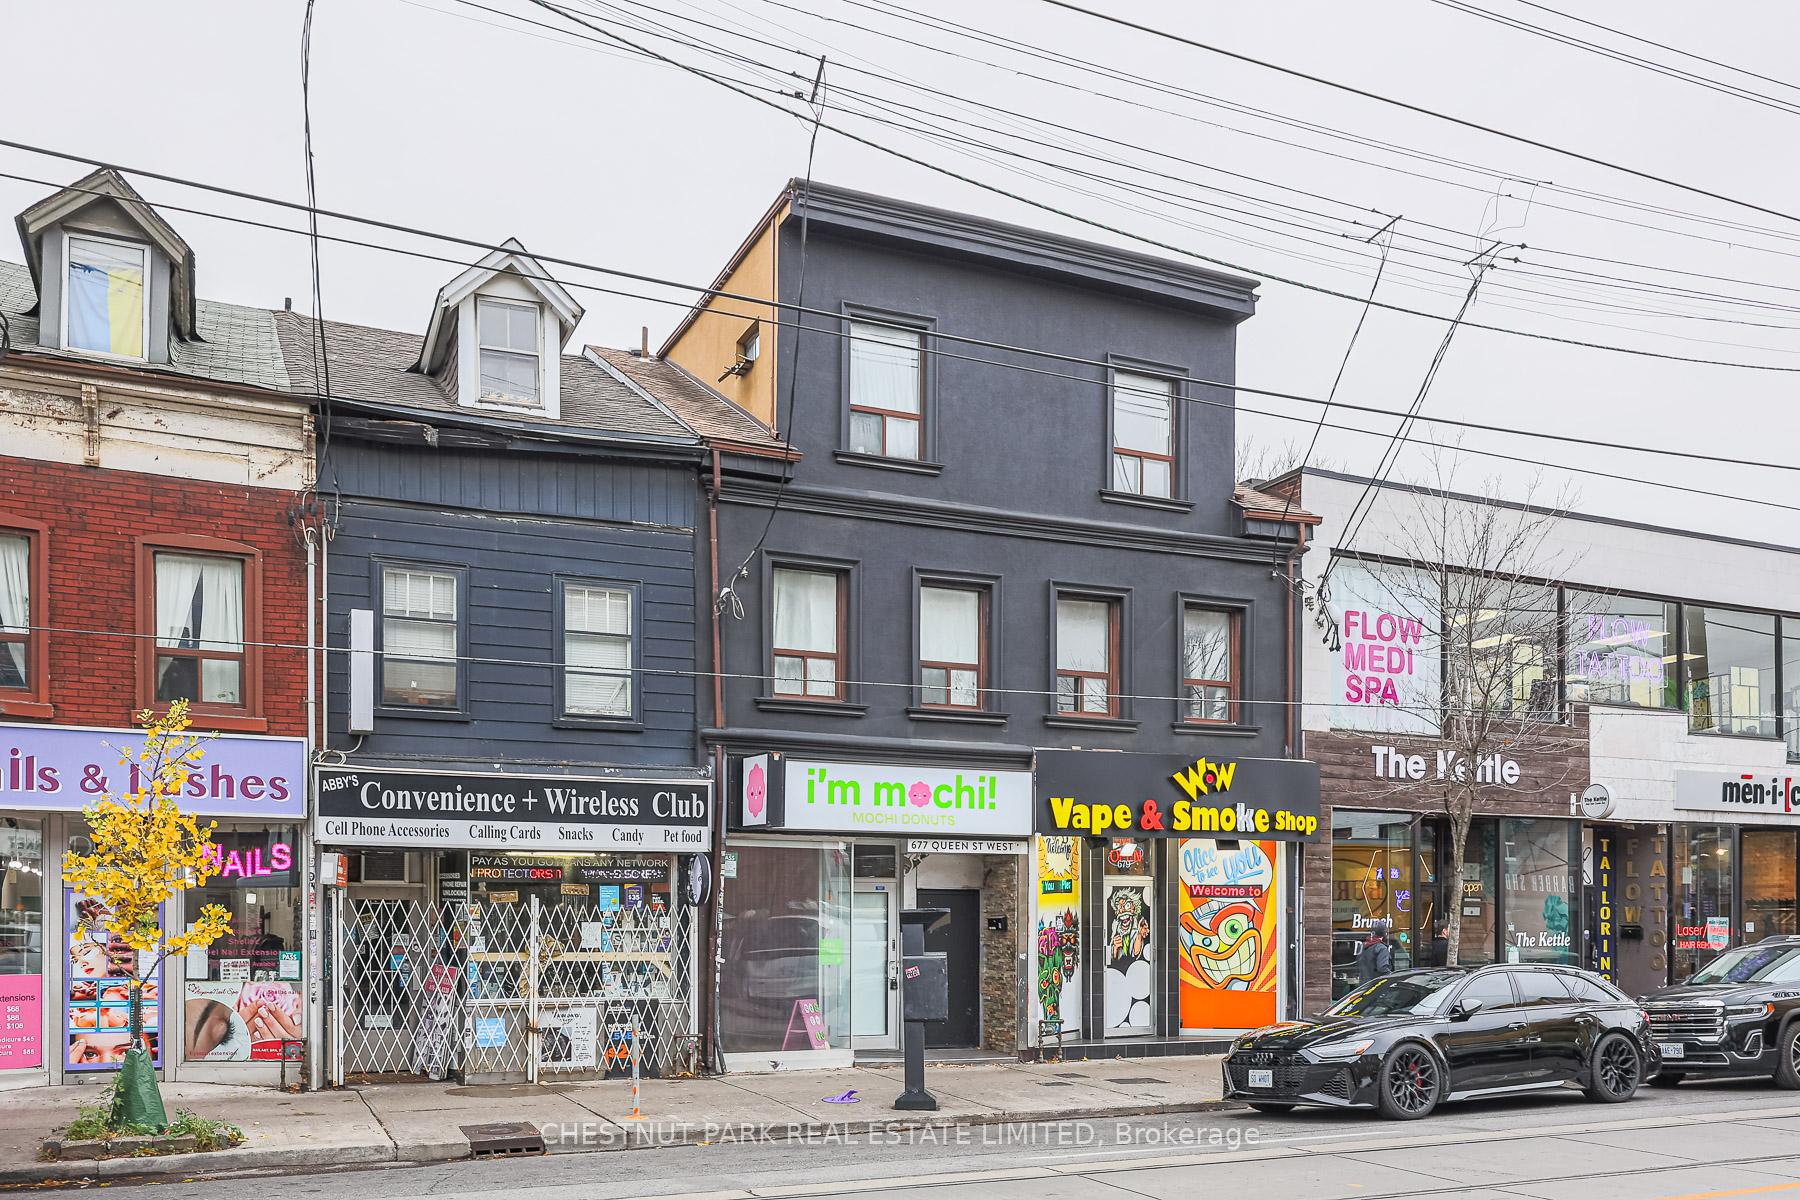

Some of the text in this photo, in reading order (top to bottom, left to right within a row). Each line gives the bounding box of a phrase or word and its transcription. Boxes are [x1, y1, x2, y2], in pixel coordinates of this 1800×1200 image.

[1345, 610, 1422, 644] FLOW
[1588, 615, 1650, 646] FLOW
[1345, 643, 1413, 675] MEDI
[1576, 650, 1664, 681] TATTOO
[1346, 675, 1399, 706] SPA
[0, 748, 61, 792] ils
[80, 764, 108, 794] &
[1372, 746, 1426, 779] The
[322, 775, 359, 792] ABBY'S
[807, 768, 860, 805] i'm
[360, 781, 516, 813] Convenience
[544, 788, 639, 817] Wireless
[652, 791, 705, 818] Club
[852, 812, 956, 826] MOCHI DONUTS
[1050, 797, 1318, 835] Vape & Smoke Shop
[325, 821, 702, 845] Cell Phone Accessories Calling Cards Snacks Candy Pet food
[911, 840, 1012, 851] 677 QUEEN ST WEST
[201, 843, 292, 878] NAILS
[472, 857, 493, 865] PAY
[494, 857, 508, 865] AS
[511, 858, 534, 866] YOU
[1110, 849, 1142, 862] ON
[1117, 860, 1131, 869] 679
[1191, 885, 1261, 896] Welcome to
[1463, 883, 1483, 896] open
[1624, 839, 1642, 923] FLOW
[1650, 837, 1666, 971] TATTOO
[1516, 932, 1571, 947] The Kettle
[282, 953, 298, 961] PASS
